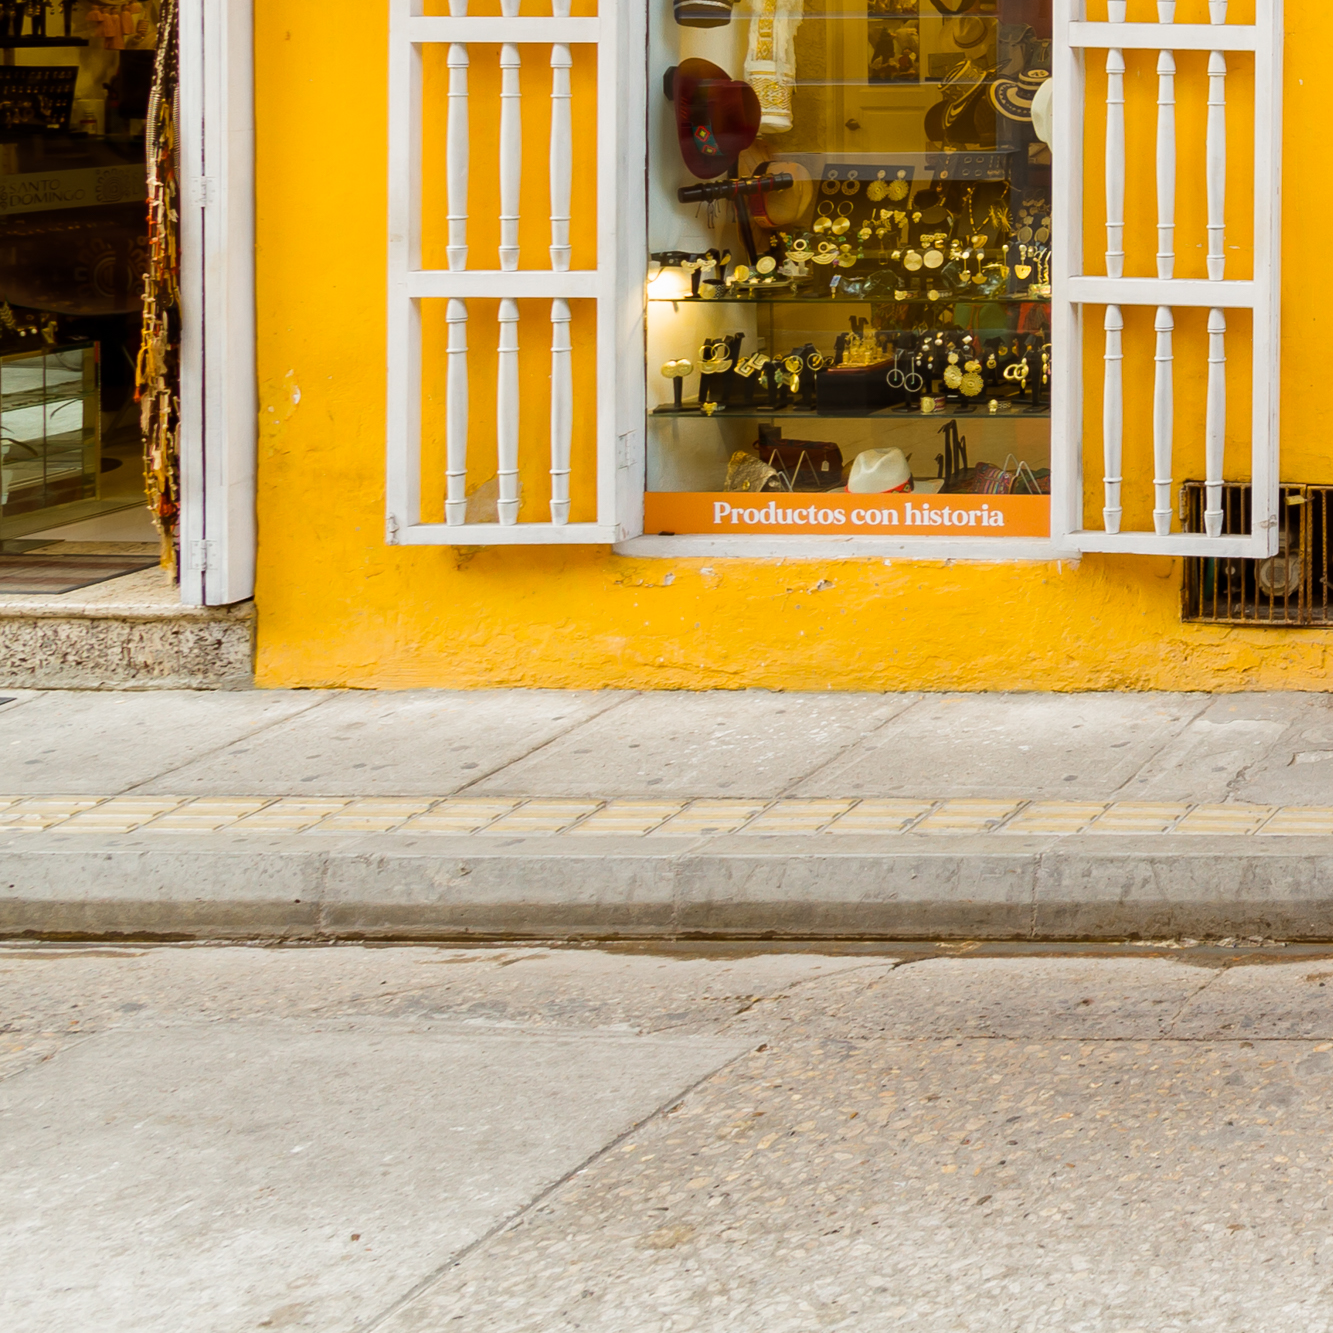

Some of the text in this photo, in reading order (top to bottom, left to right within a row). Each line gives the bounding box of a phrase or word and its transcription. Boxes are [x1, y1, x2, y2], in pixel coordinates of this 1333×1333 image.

[9, 179, 60, 194] SANTO
[10, 189, 86, 206] DOMINGO
[712, 501, 1005, 527] Productos con historia
